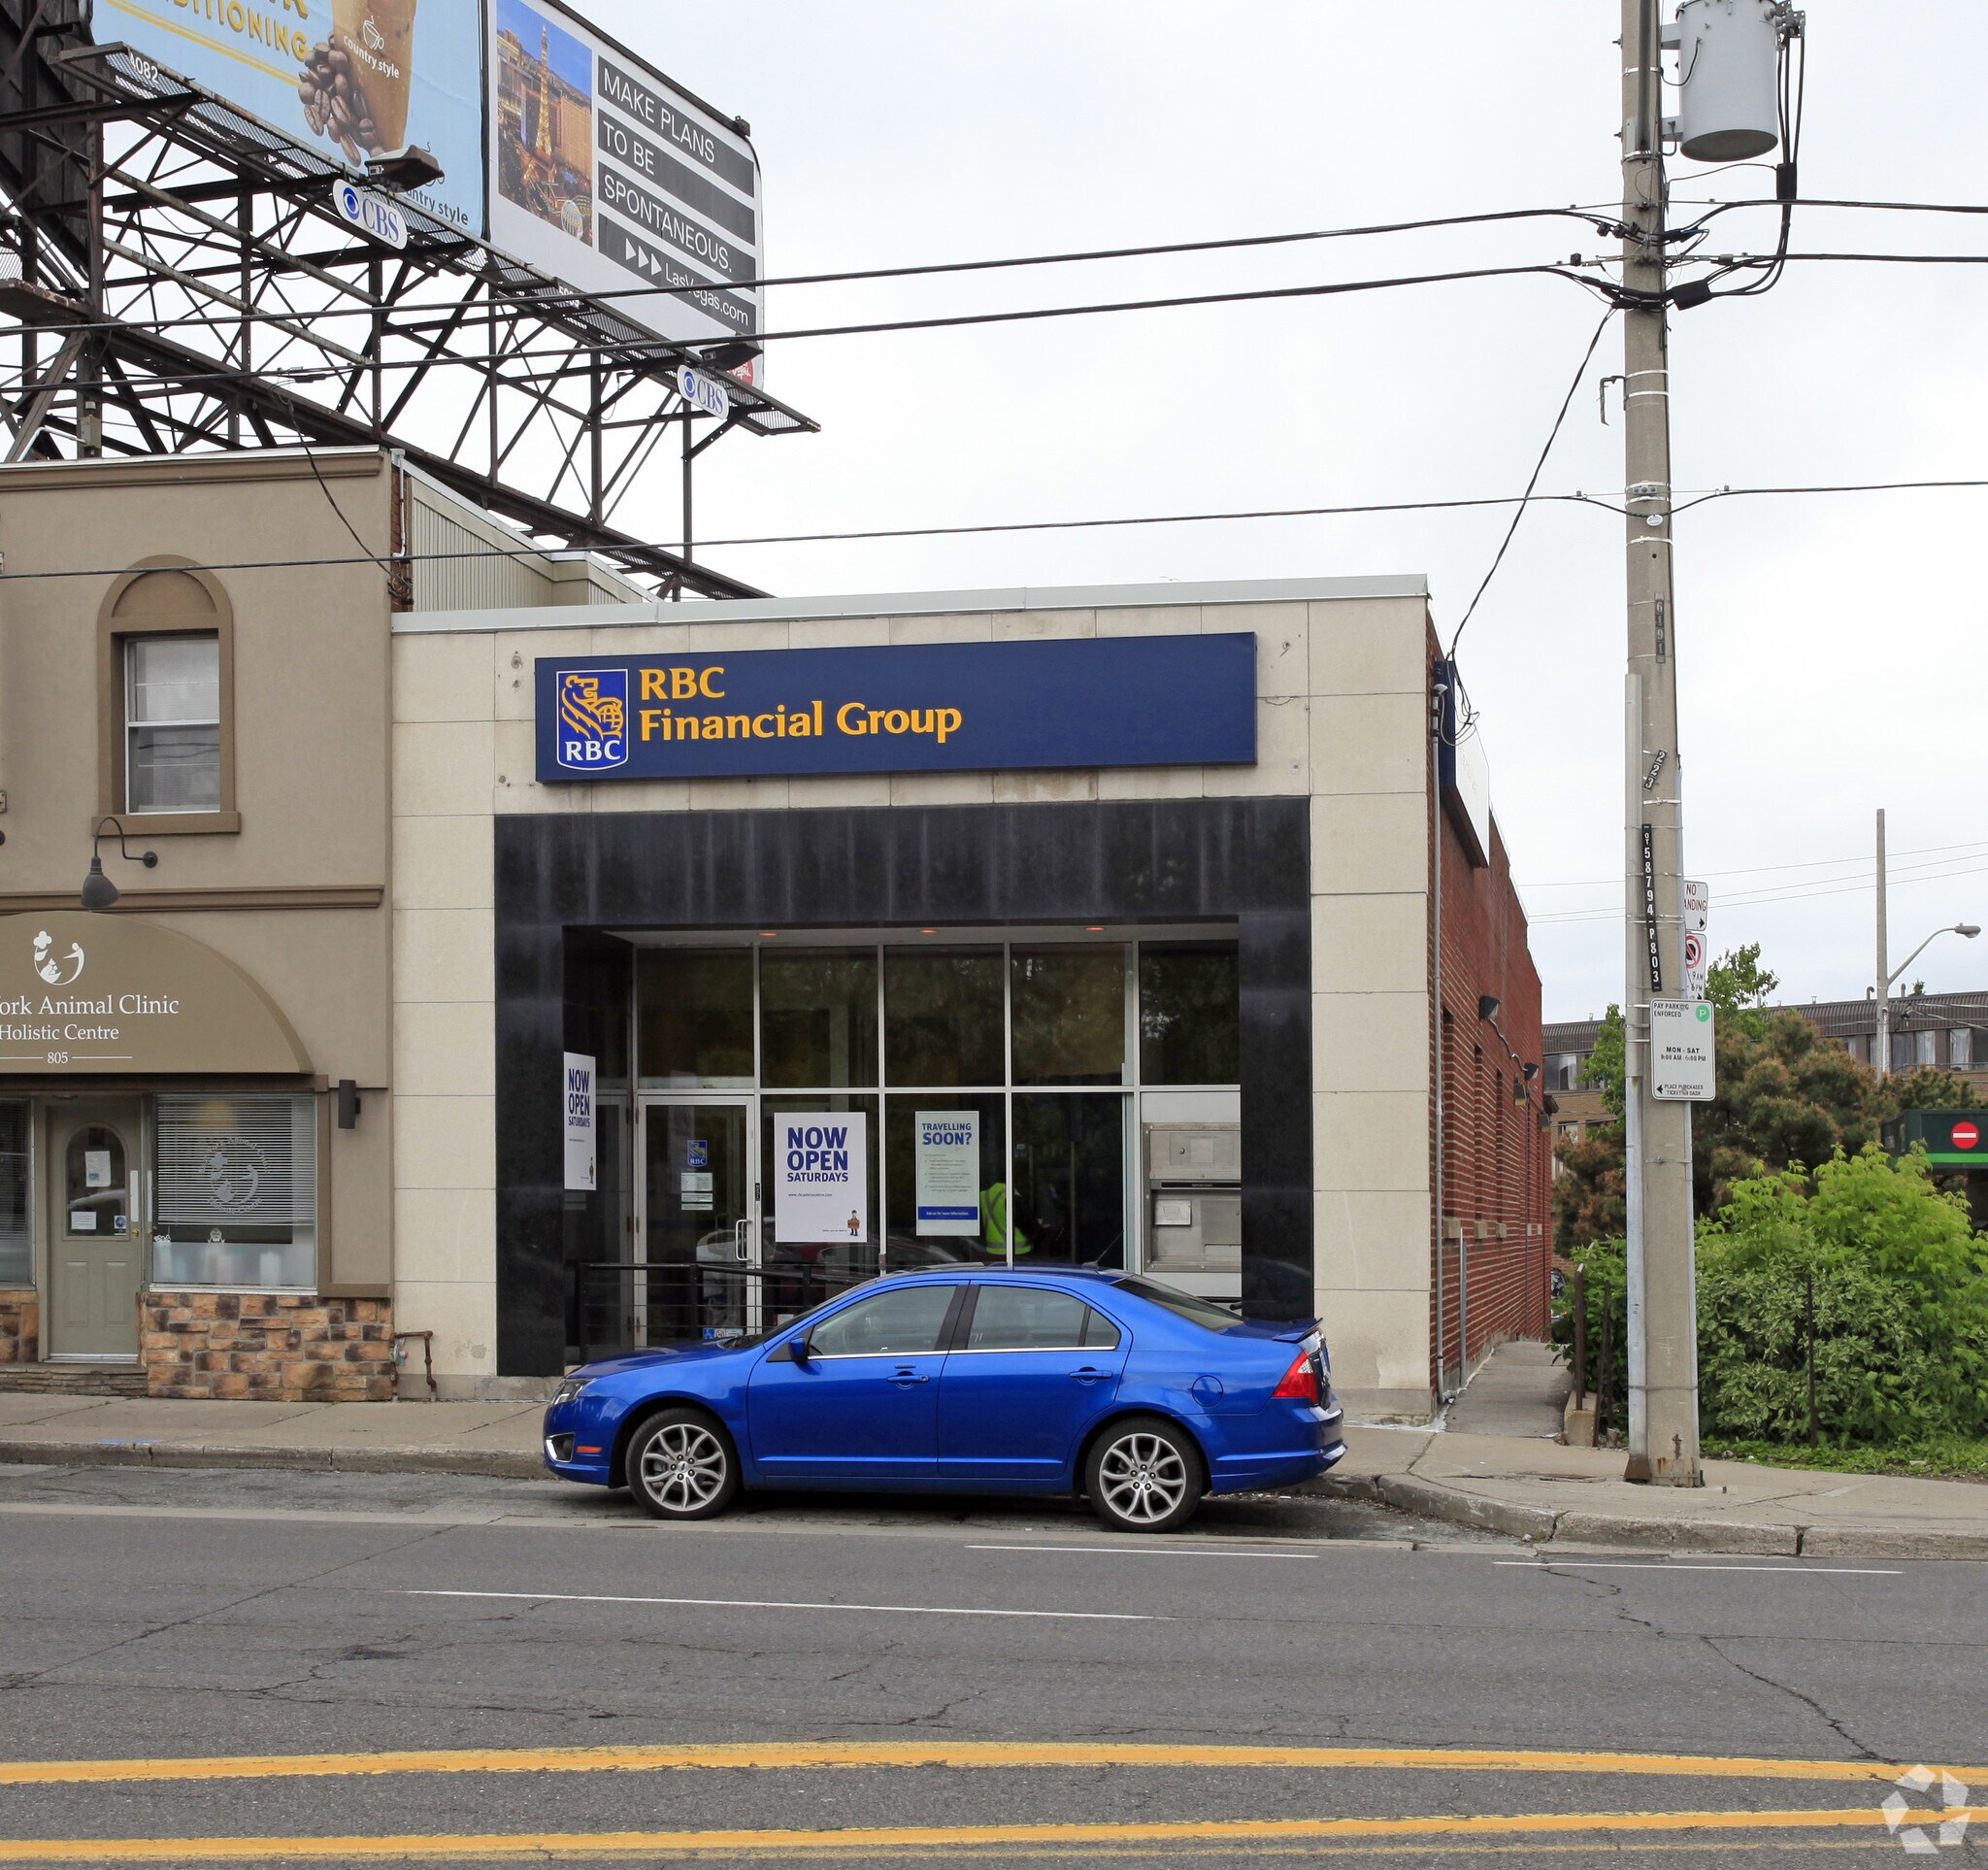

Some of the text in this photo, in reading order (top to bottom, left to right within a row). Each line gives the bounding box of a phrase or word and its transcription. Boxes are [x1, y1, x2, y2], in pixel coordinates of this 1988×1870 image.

[173, 0, 310, 62] ITIONING
[343, 35, 400, 79] country style
[604, 67, 714, 163] MAKE PLANS
[603, 120, 654, 176] TO BE
[406, 188, 469, 225] untry style
[362, 198, 399, 243] CBS
[604, 174, 732, 273] SPONTANEOUS.
[665, 262, 748, 326] LasVegas.com
[697, 379, 724, 415] CBS
[639, 666, 726, 700] RBC
[639, 700, 963, 744] Financial Group
[565, 740, 621, 761] RBC
[1644, 751, 1667, 788] 223
[1686, 884, 1697, 895] NO
[1684, 899, 1706, 912] ANDING
[0, 994, 180, 1015] ork Animal Clinic
[0, 1023, 119, 1040] Holistic Centre
[47, 1052, 69, 1064] 805
[568, 1068, 590, 1093] NOW
[568, 1092, 590, 1117] OPEN
[568, 1116, 591, 1128] SATURDAYS
[921, 1122, 972, 1131] TRAVELLING
[787, 1126, 848, 1150] NOW
[922, 1132, 973, 1146] SOON?
[786, 1150, 848, 1171] OPEN
[786, 1172, 848, 1183] SATURDAYS
